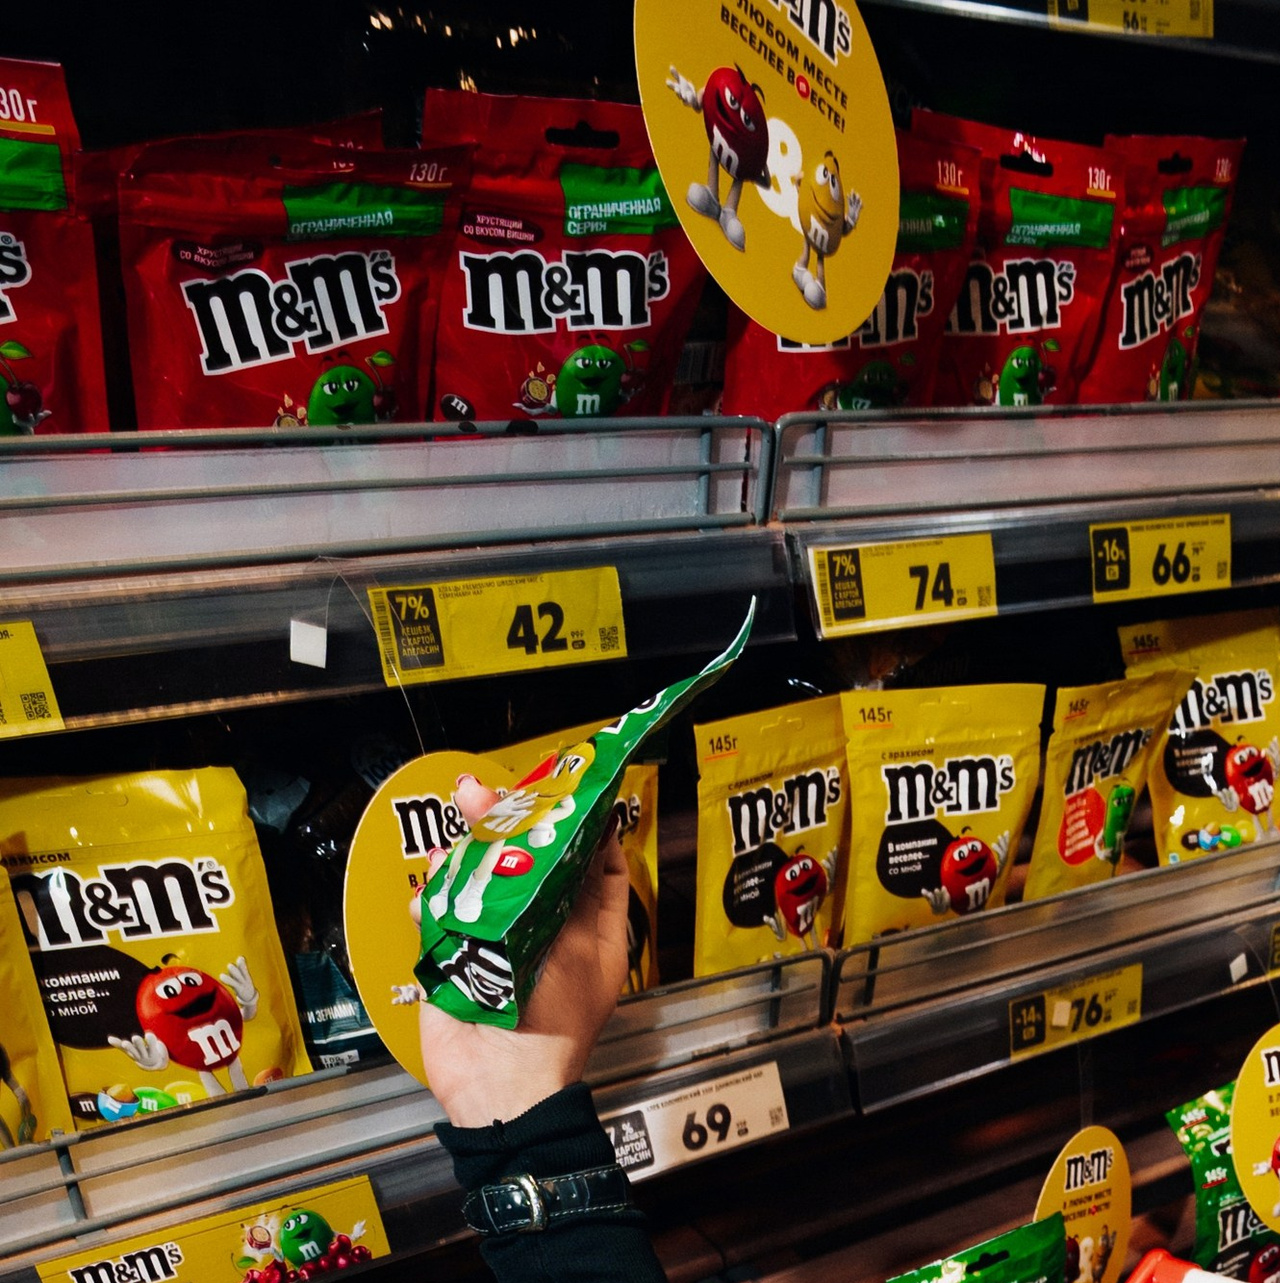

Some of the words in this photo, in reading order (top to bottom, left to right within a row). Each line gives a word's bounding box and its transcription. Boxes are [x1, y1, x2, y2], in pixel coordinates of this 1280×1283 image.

[721, 4, 785, 77] ВЕСЕЛЕЕ
[803, 54, 848, 110] МЕСТЕ
[711, 122, 740, 178] m
[409, 162, 449, 184] 130г
[937, 160, 964, 187] 130г
[1087, 166, 1112, 190] 130г
[568, 197, 661, 220] ОГРАНИЧЕННАЯ
[291, 209, 394, 235] ОГРАНИЧЕННАЯ
[463, 225, 475, 235] СО
[475, 225, 506, 239] ВКУСОМ
[506, 228, 535, 243] ВИШНИ
[476, 213, 523, 231] ХРУСТЯЩИЙ
[567, 221, 608, 235] СЕРИЯ
[809, 214, 829, 250] m
[459, 249, 671, 335] m&m's
[180, 250, 402, 376] m&m's
[450, 395, 469, 416] m
[576, 394, 601, 415] m
[832, 554, 856, 578] 7%
[1152, 541, 1191, 586] 66
[909, 562, 955, 611] 74
[395, 593, 430, 621] 7%
[401, 638, 407, 647] С
[408, 632, 436, 646] КАРТОЙ
[506, 601, 568, 656] 42
[401, 645, 440, 658] АПЕЛЬСИН
[1133, 635, 1160, 649] 145г
[859, 707, 893, 724] 145г
[708, 735, 738, 755] 145г
[889, 748, 935, 760] арахисом
[881, 754, 1016, 826] m&m's
[726, 765, 842, 858] m&m's
[889, 866, 900, 875] со
[902, 862, 922, 874] мной
[965, 877, 990, 910] m
[797, 896, 819, 932] m
[58, 1002, 98, 1017] мной
[1071, 993, 1103, 1033] 76
[188, 1018, 241, 1067] m
[621, 1120, 634, 1135] %
[682, 1103, 732, 1151] 69
[616, 1138, 648, 1157] КАРТОЙ
[298, 1241, 322, 1261] m
